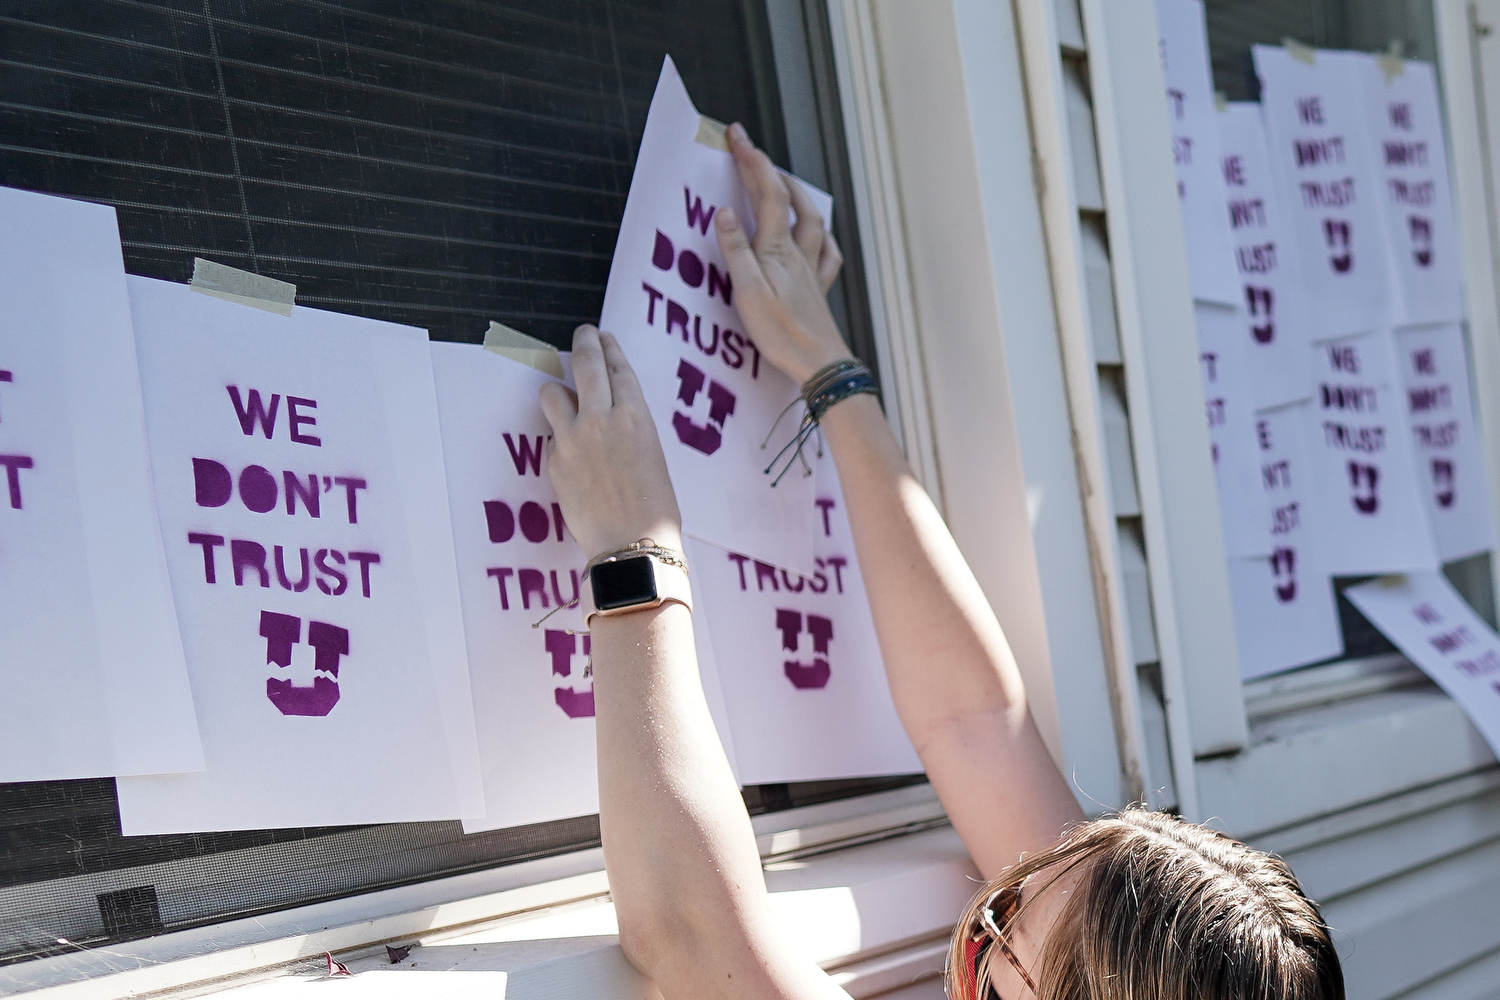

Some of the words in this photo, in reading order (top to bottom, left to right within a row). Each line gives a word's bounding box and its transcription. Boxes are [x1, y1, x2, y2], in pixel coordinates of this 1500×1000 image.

[684, 186, 716, 236] W
[652, 227, 732, 306] DON
[225, 386, 323, 447] WE
[672, 357, 736, 456] U
[502, 432, 546, 477] W
[191, 456, 367, 525] DON'T
[187, 532, 382, 599] TRUST
[486, 566, 580, 614] TRU
[258, 610, 349, 716] U
[775, 608, 833, 690] U
